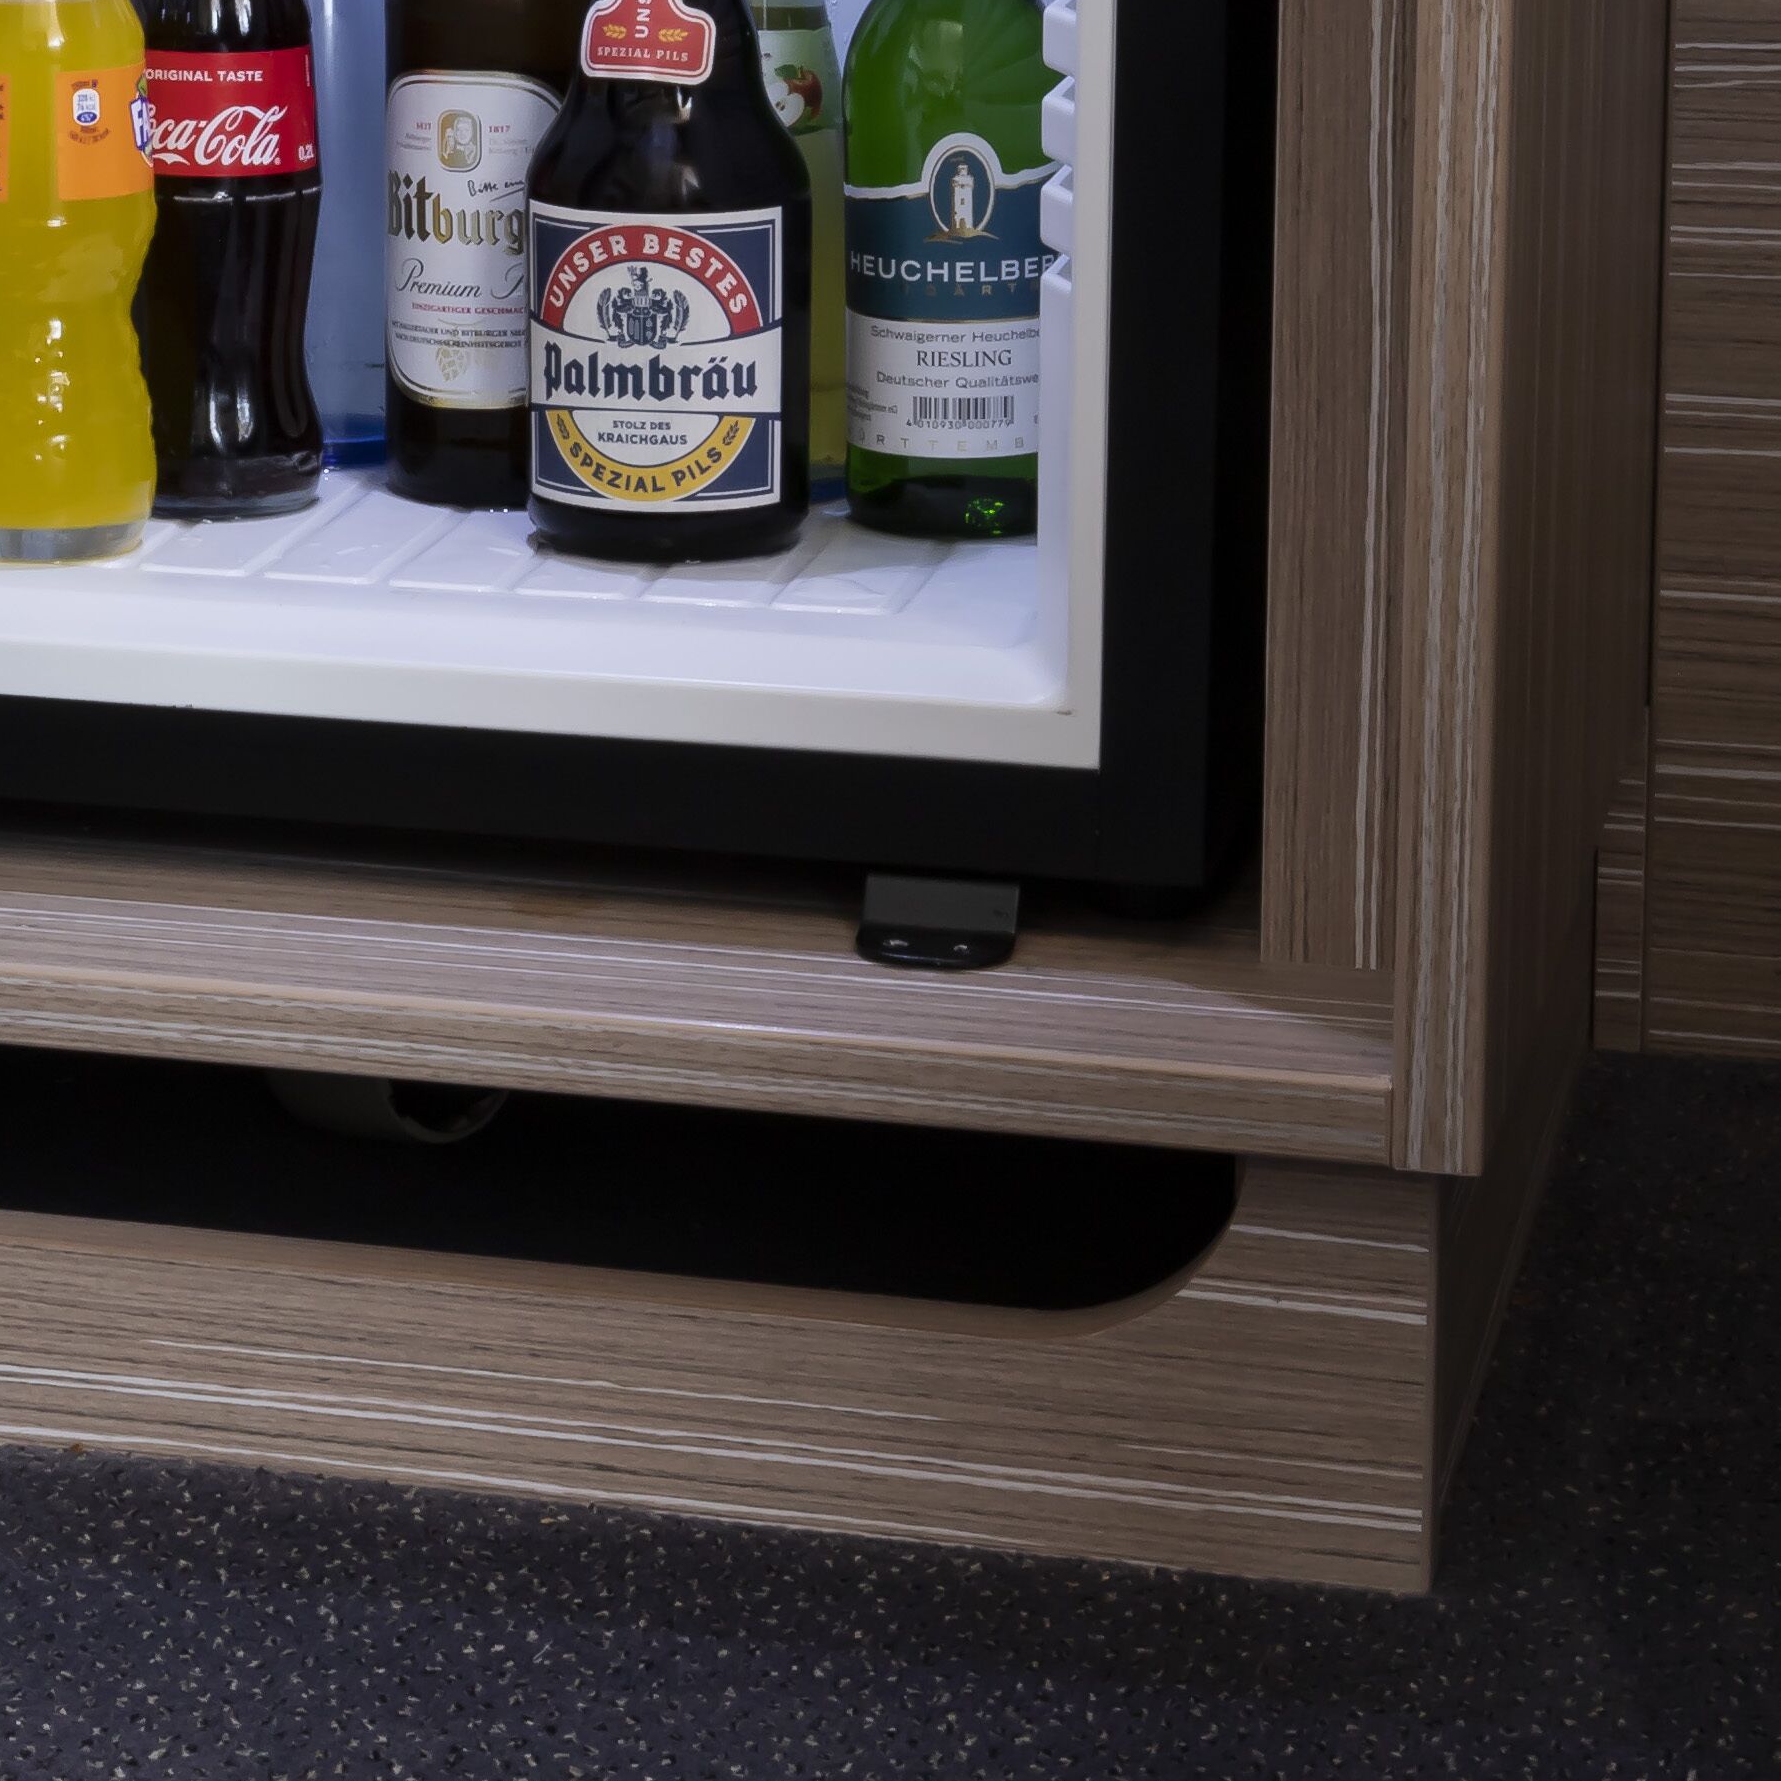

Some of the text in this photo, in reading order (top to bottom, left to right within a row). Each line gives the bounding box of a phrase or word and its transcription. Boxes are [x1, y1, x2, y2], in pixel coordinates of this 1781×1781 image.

[597, 46, 689, 62] SPEZIAL PILS
[146, 69, 263, 82] ORIGINAL TASTE
[396, 257, 482, 298] Premium
[549, 233, 749, 314] UNSER BESTES
[870, 325, 966, 344] Schwaigerner
[916, 349, 1012, 367] RIESLING
[543, 339, 758, 402] Palmbräu
[876, 370, 950, 388] Deutscher
[612, 420, 672, 431] STOLZ DES
[597, 432, 688, 446] KRAICHGAUS
[569, 441, 723, 493] SPEZIAL PILS
